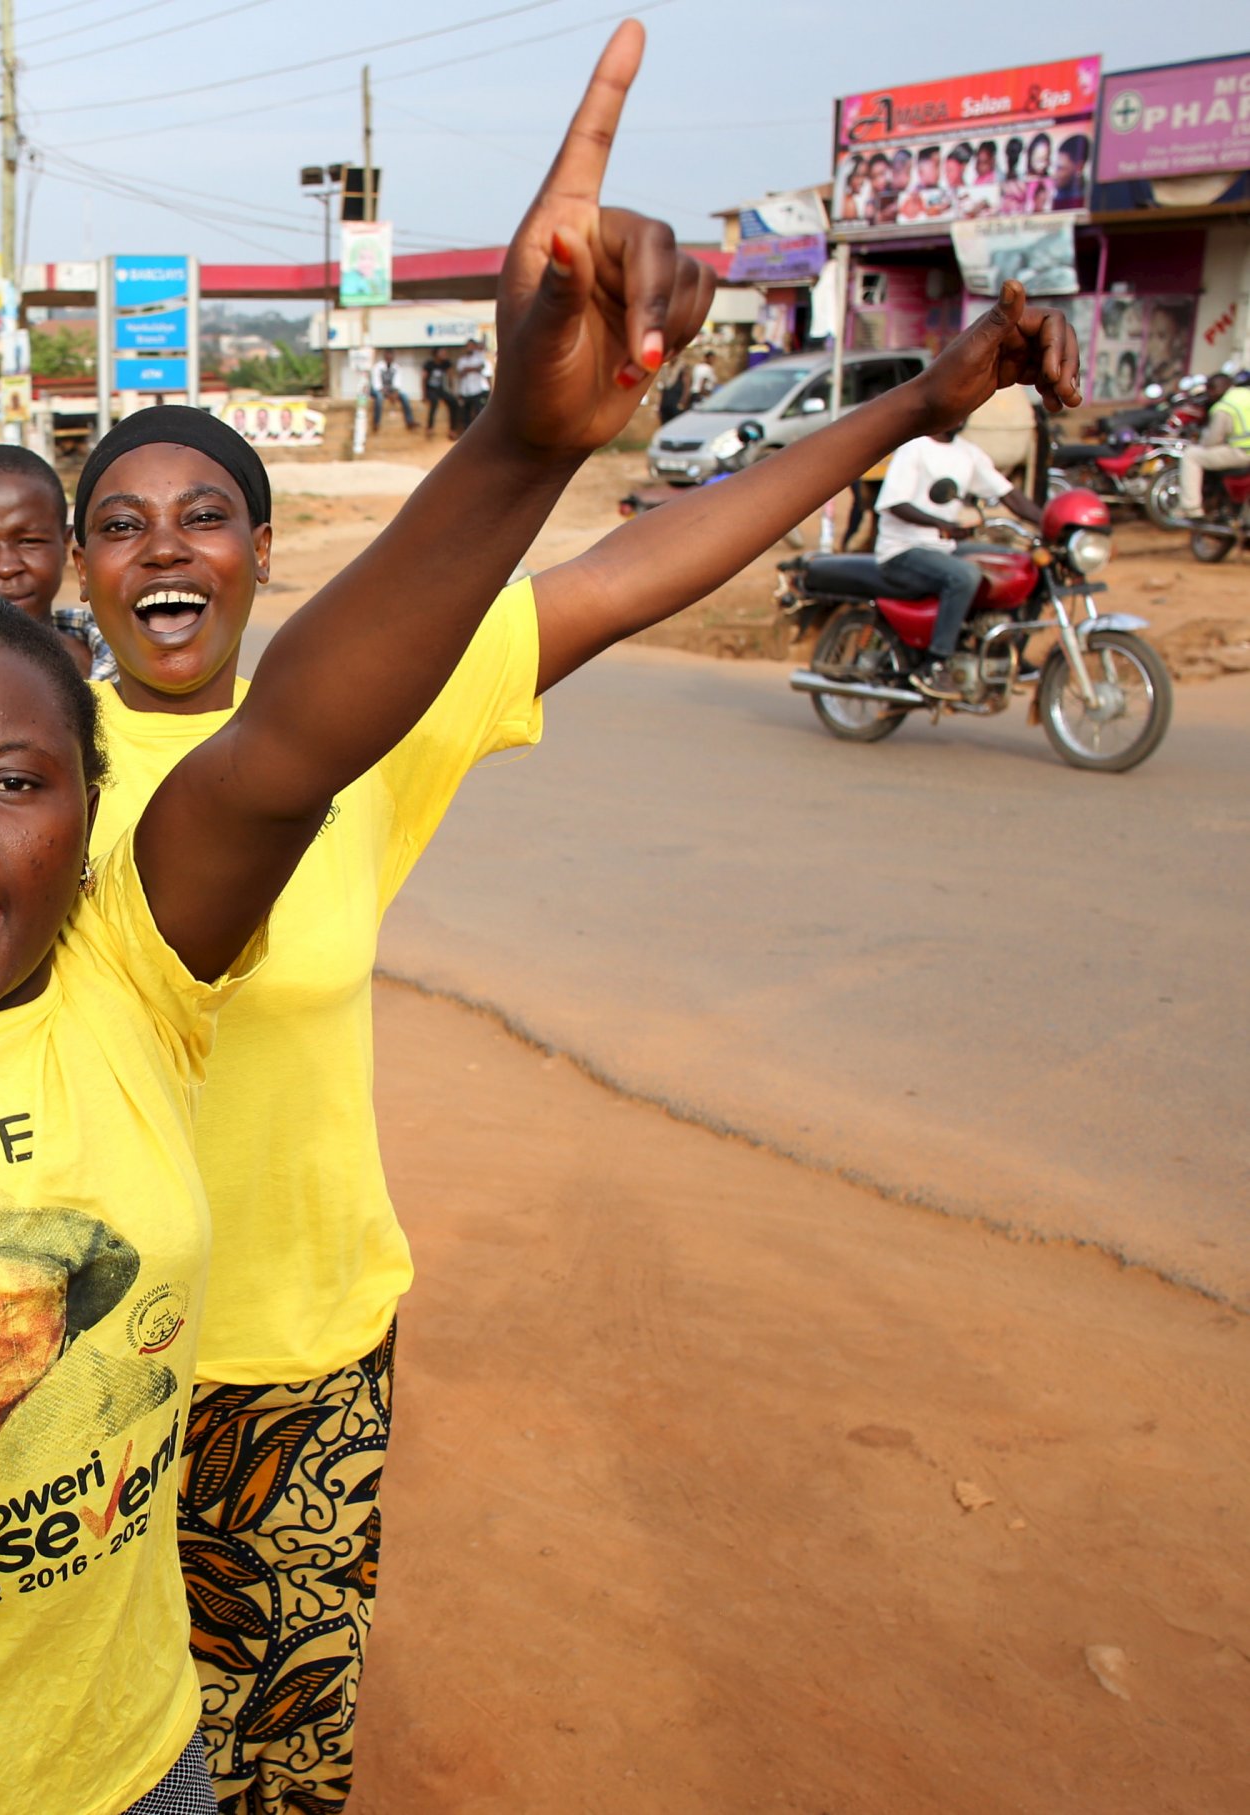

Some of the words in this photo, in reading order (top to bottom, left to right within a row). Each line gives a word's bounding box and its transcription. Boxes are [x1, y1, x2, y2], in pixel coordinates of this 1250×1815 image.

[1039, 89, 1071, 111] Spa
[129, 268, 184, 282] BARCLAYS
[18, 1557, 87, 1593] 2016
[94, 1552, 104, 1561] -
[110, 1508, 151, 1555] 202
